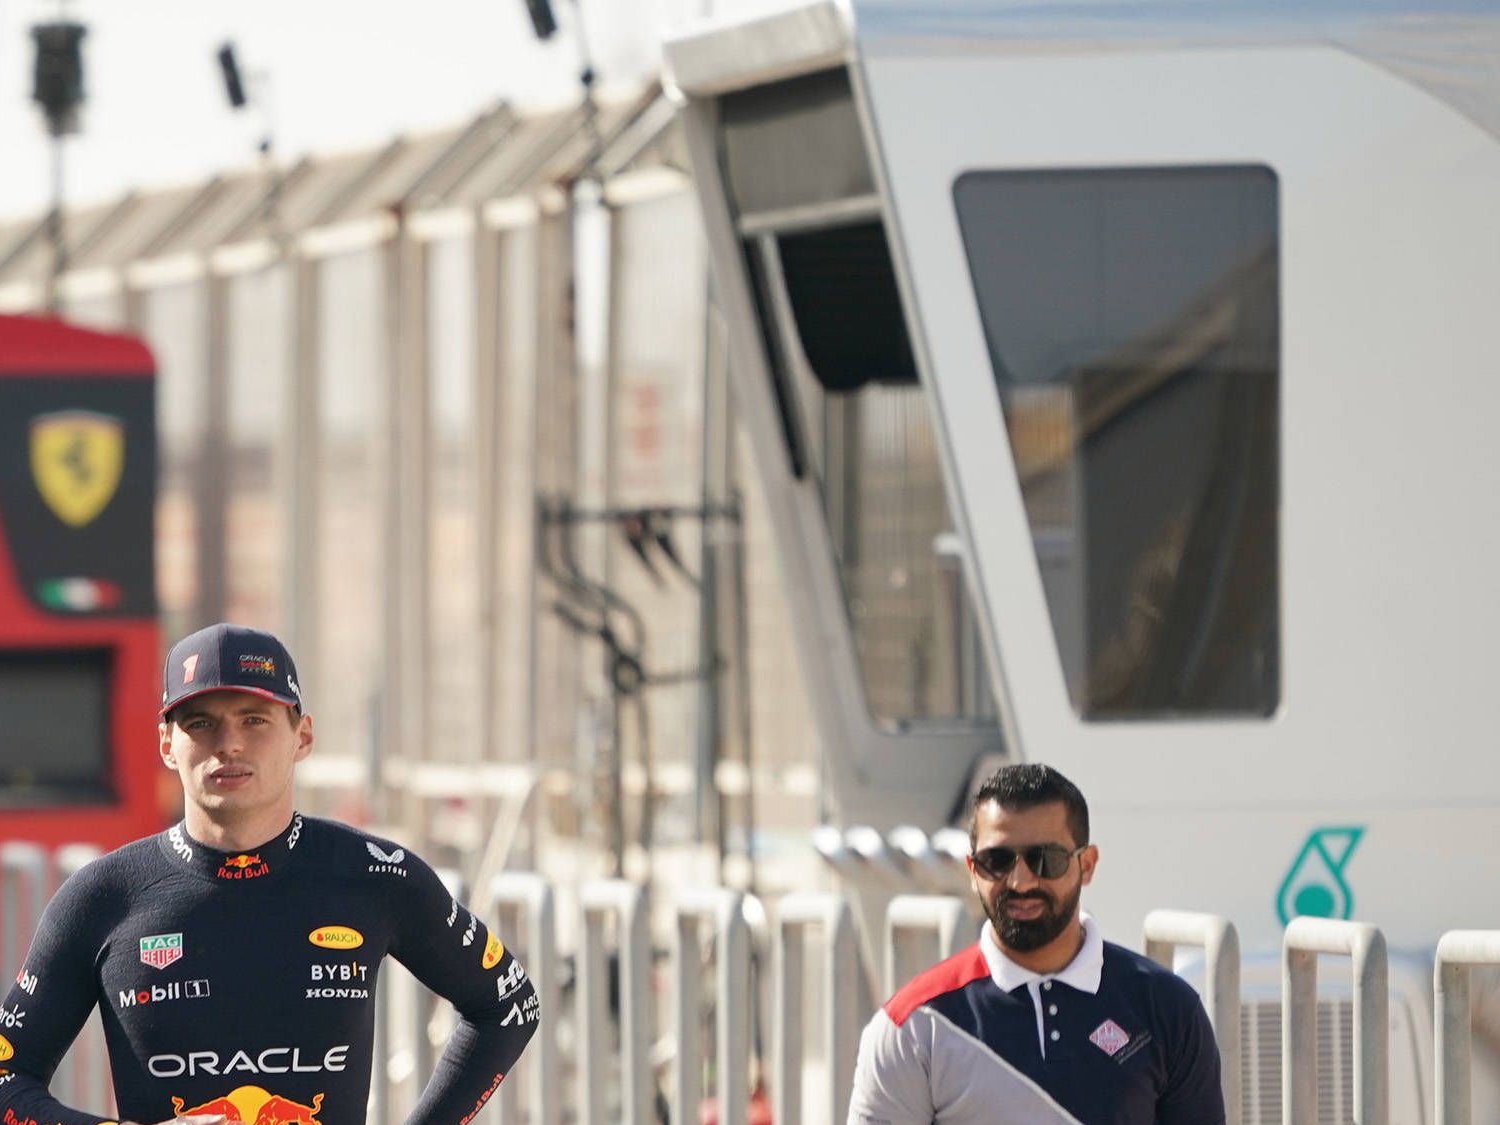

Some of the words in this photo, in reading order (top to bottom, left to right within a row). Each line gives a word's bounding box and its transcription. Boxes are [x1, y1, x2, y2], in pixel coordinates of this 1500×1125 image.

[182, 653, 200, 684] 1
[217, 866, 242, 879] Red
[245, 863, 270, 879] Bull
[143, 936, 180, 949] TAG
[323, 932, 358, 944] RAUCH
[142, 948, 182, 966] HEUER
[310, 961, 368, 982] BYBIT
[118, 981, 181, 1009] Mobil
[304, 988, 369, 1000] HONDA
[147, 1045, 350, 1079] ORACLE
